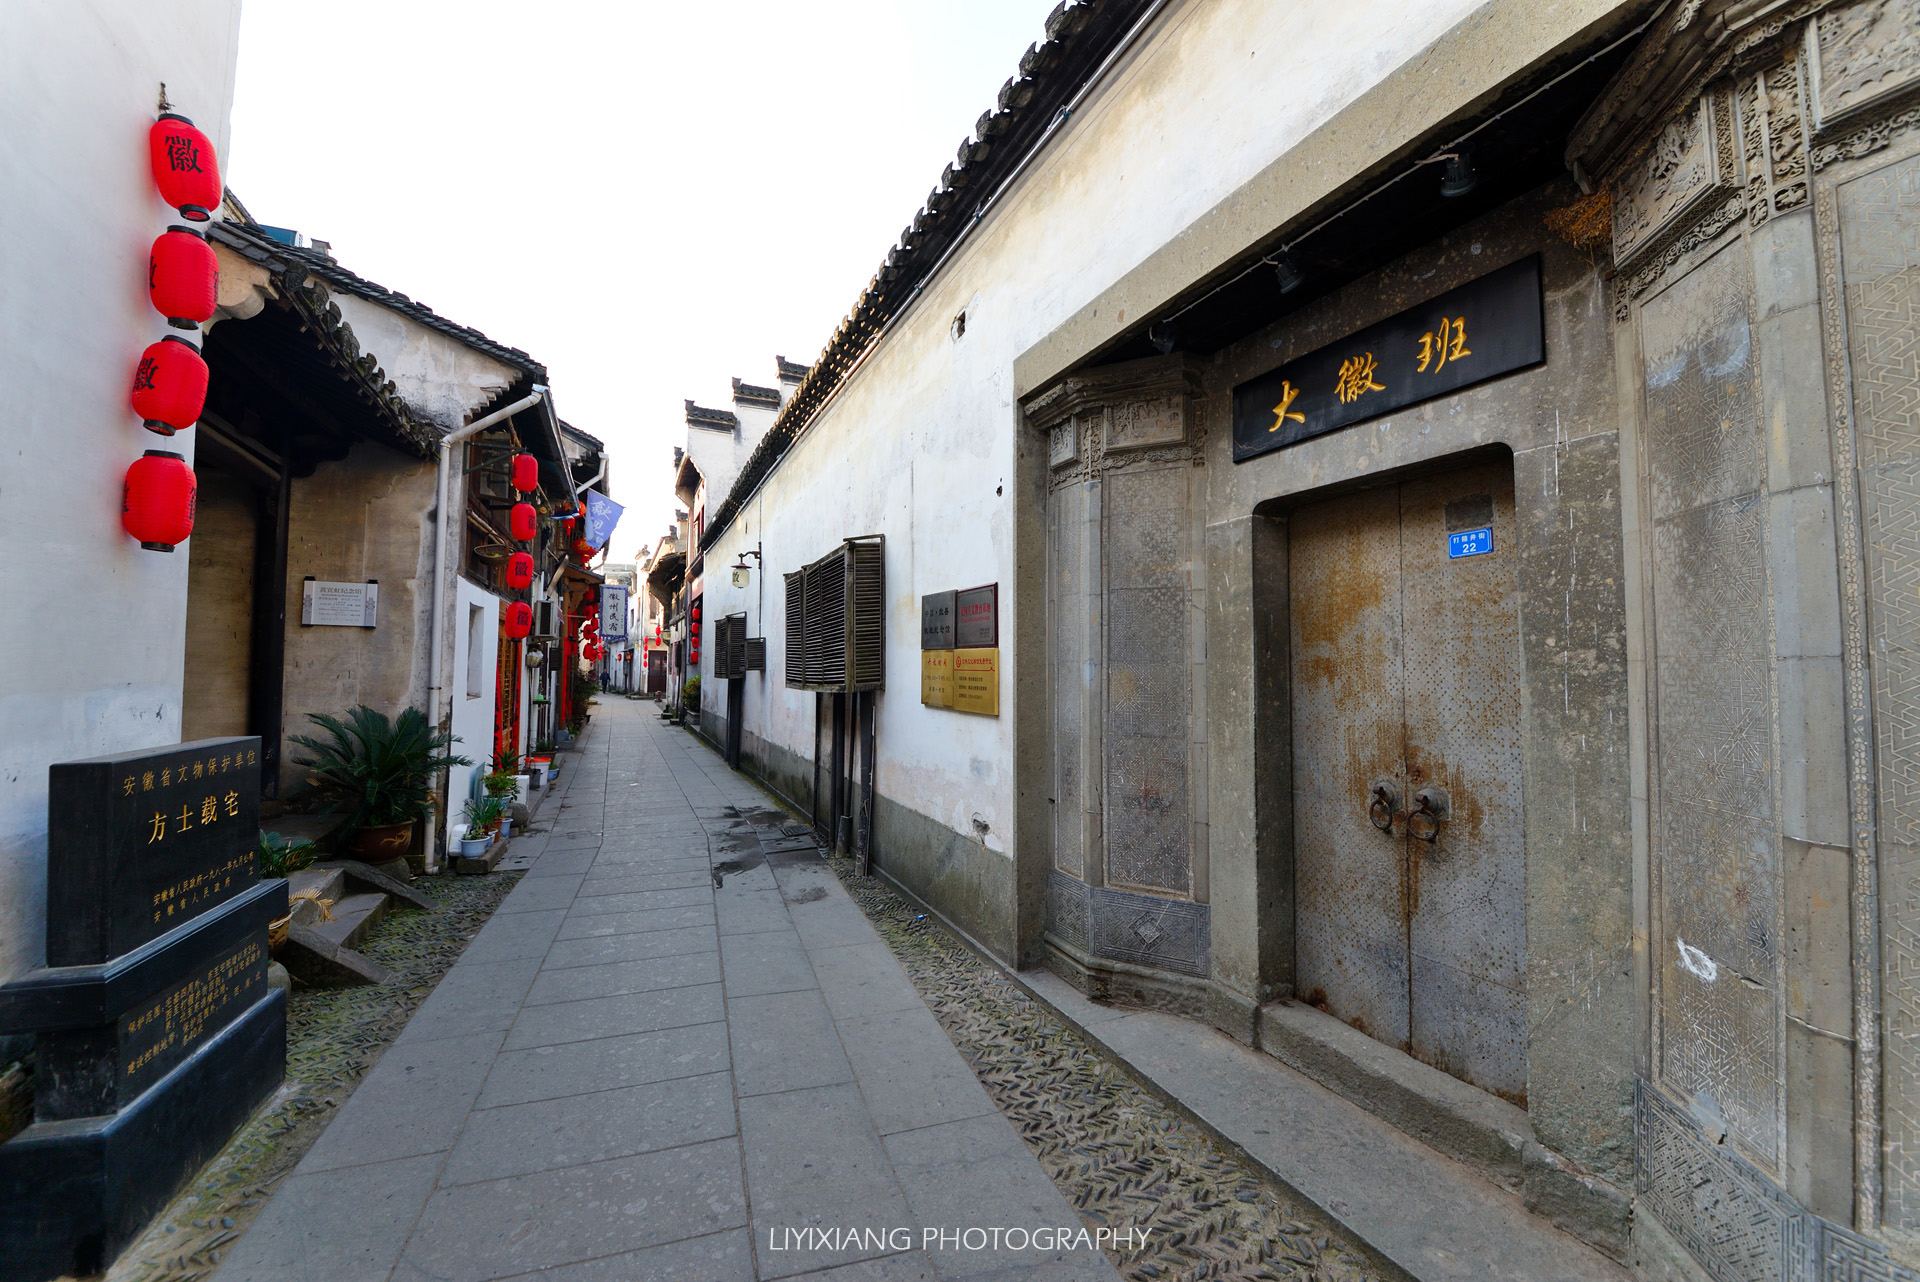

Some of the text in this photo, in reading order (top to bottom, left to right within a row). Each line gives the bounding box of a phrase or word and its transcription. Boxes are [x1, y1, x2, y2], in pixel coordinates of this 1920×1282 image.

[164, 135, 204, 174] 徽
[1268, 316, 1472, 432] 大徽班
[1462, 542, 1477, 553] 22
[608, 592, 620, 632] 徽州民宿
[123, 749, 256, 797] 安徽省文物保护单位
[148, 790, 239, 845] 方士载宅
